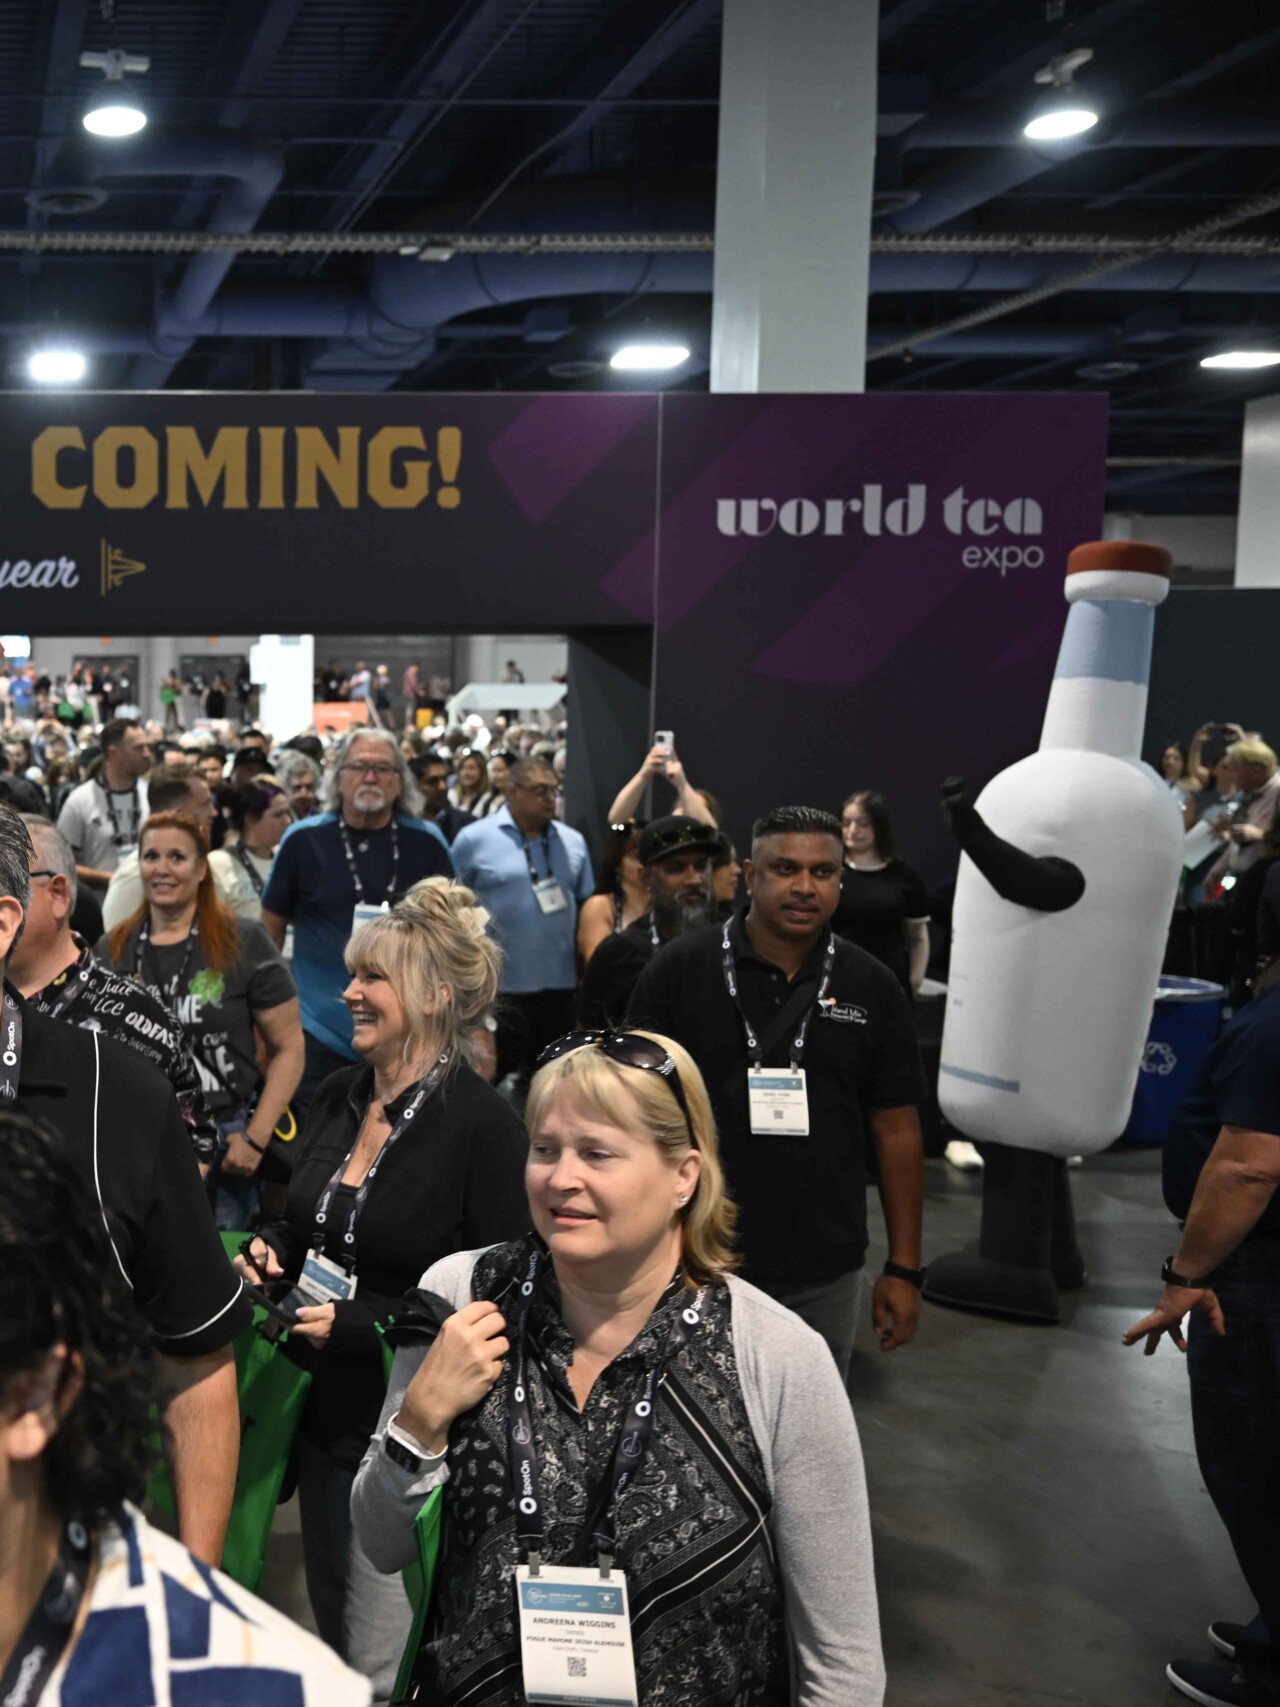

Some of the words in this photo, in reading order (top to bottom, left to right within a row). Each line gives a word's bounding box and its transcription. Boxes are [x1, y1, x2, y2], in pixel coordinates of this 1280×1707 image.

[32, 426, 462, 509] COMING!
[716, 484, 926, 537] world
[943, 486, 1043, 535] tea
[962, 546, 1044, 576] expo
[6, 1021, 16, 1051] SpotOn
[526, 1249, 538, 1281] SpotOn
[522, 1459, 533, 1497] SpotOn
[532, 1617, 575, 1626] ANDREENA
[578, 1620, 616, 1629] WIGGINS
